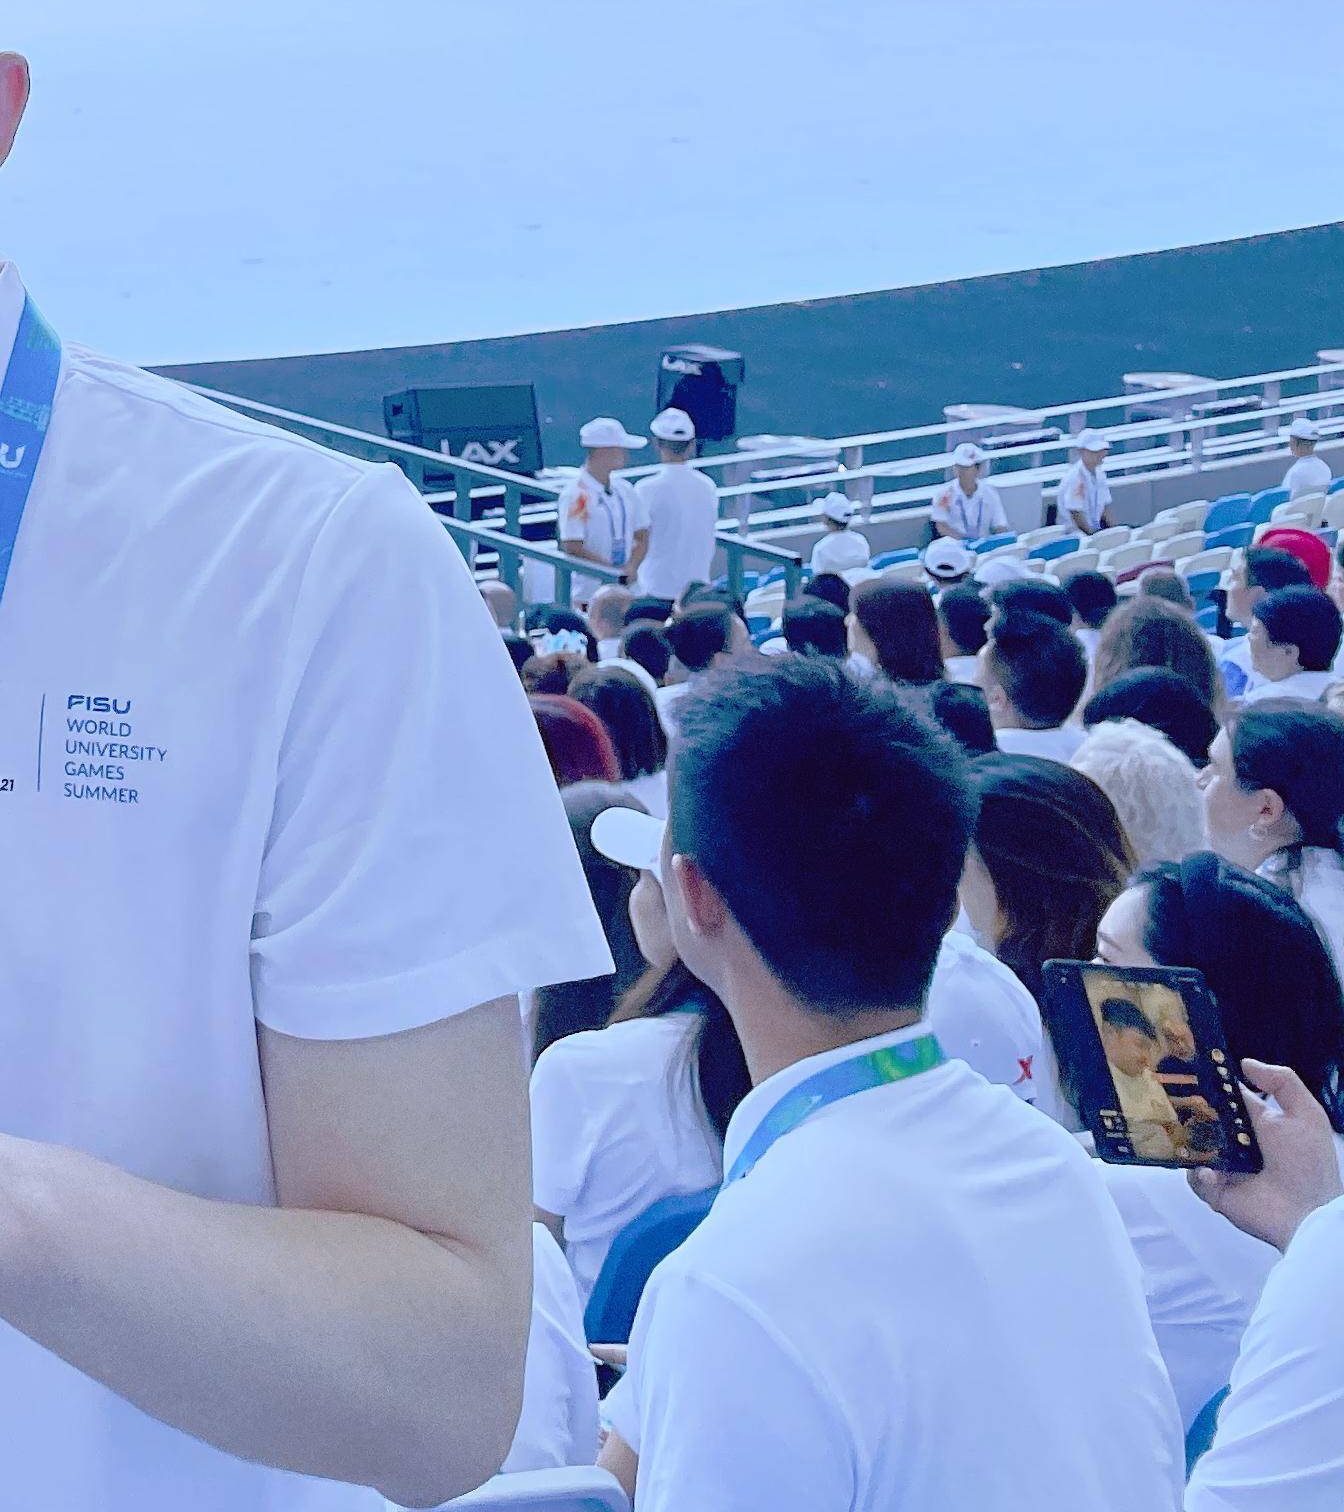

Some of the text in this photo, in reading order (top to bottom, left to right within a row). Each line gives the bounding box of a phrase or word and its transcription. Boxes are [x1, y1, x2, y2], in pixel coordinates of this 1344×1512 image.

[66, 694, 132, 715] FISU
[66, 718, 132, 738] WORLD
[65, 739, 168, 763] UNIVERSITY
[64, 761, 125, 781] GAMES
[63, 782, 139, 804] SUMMER
